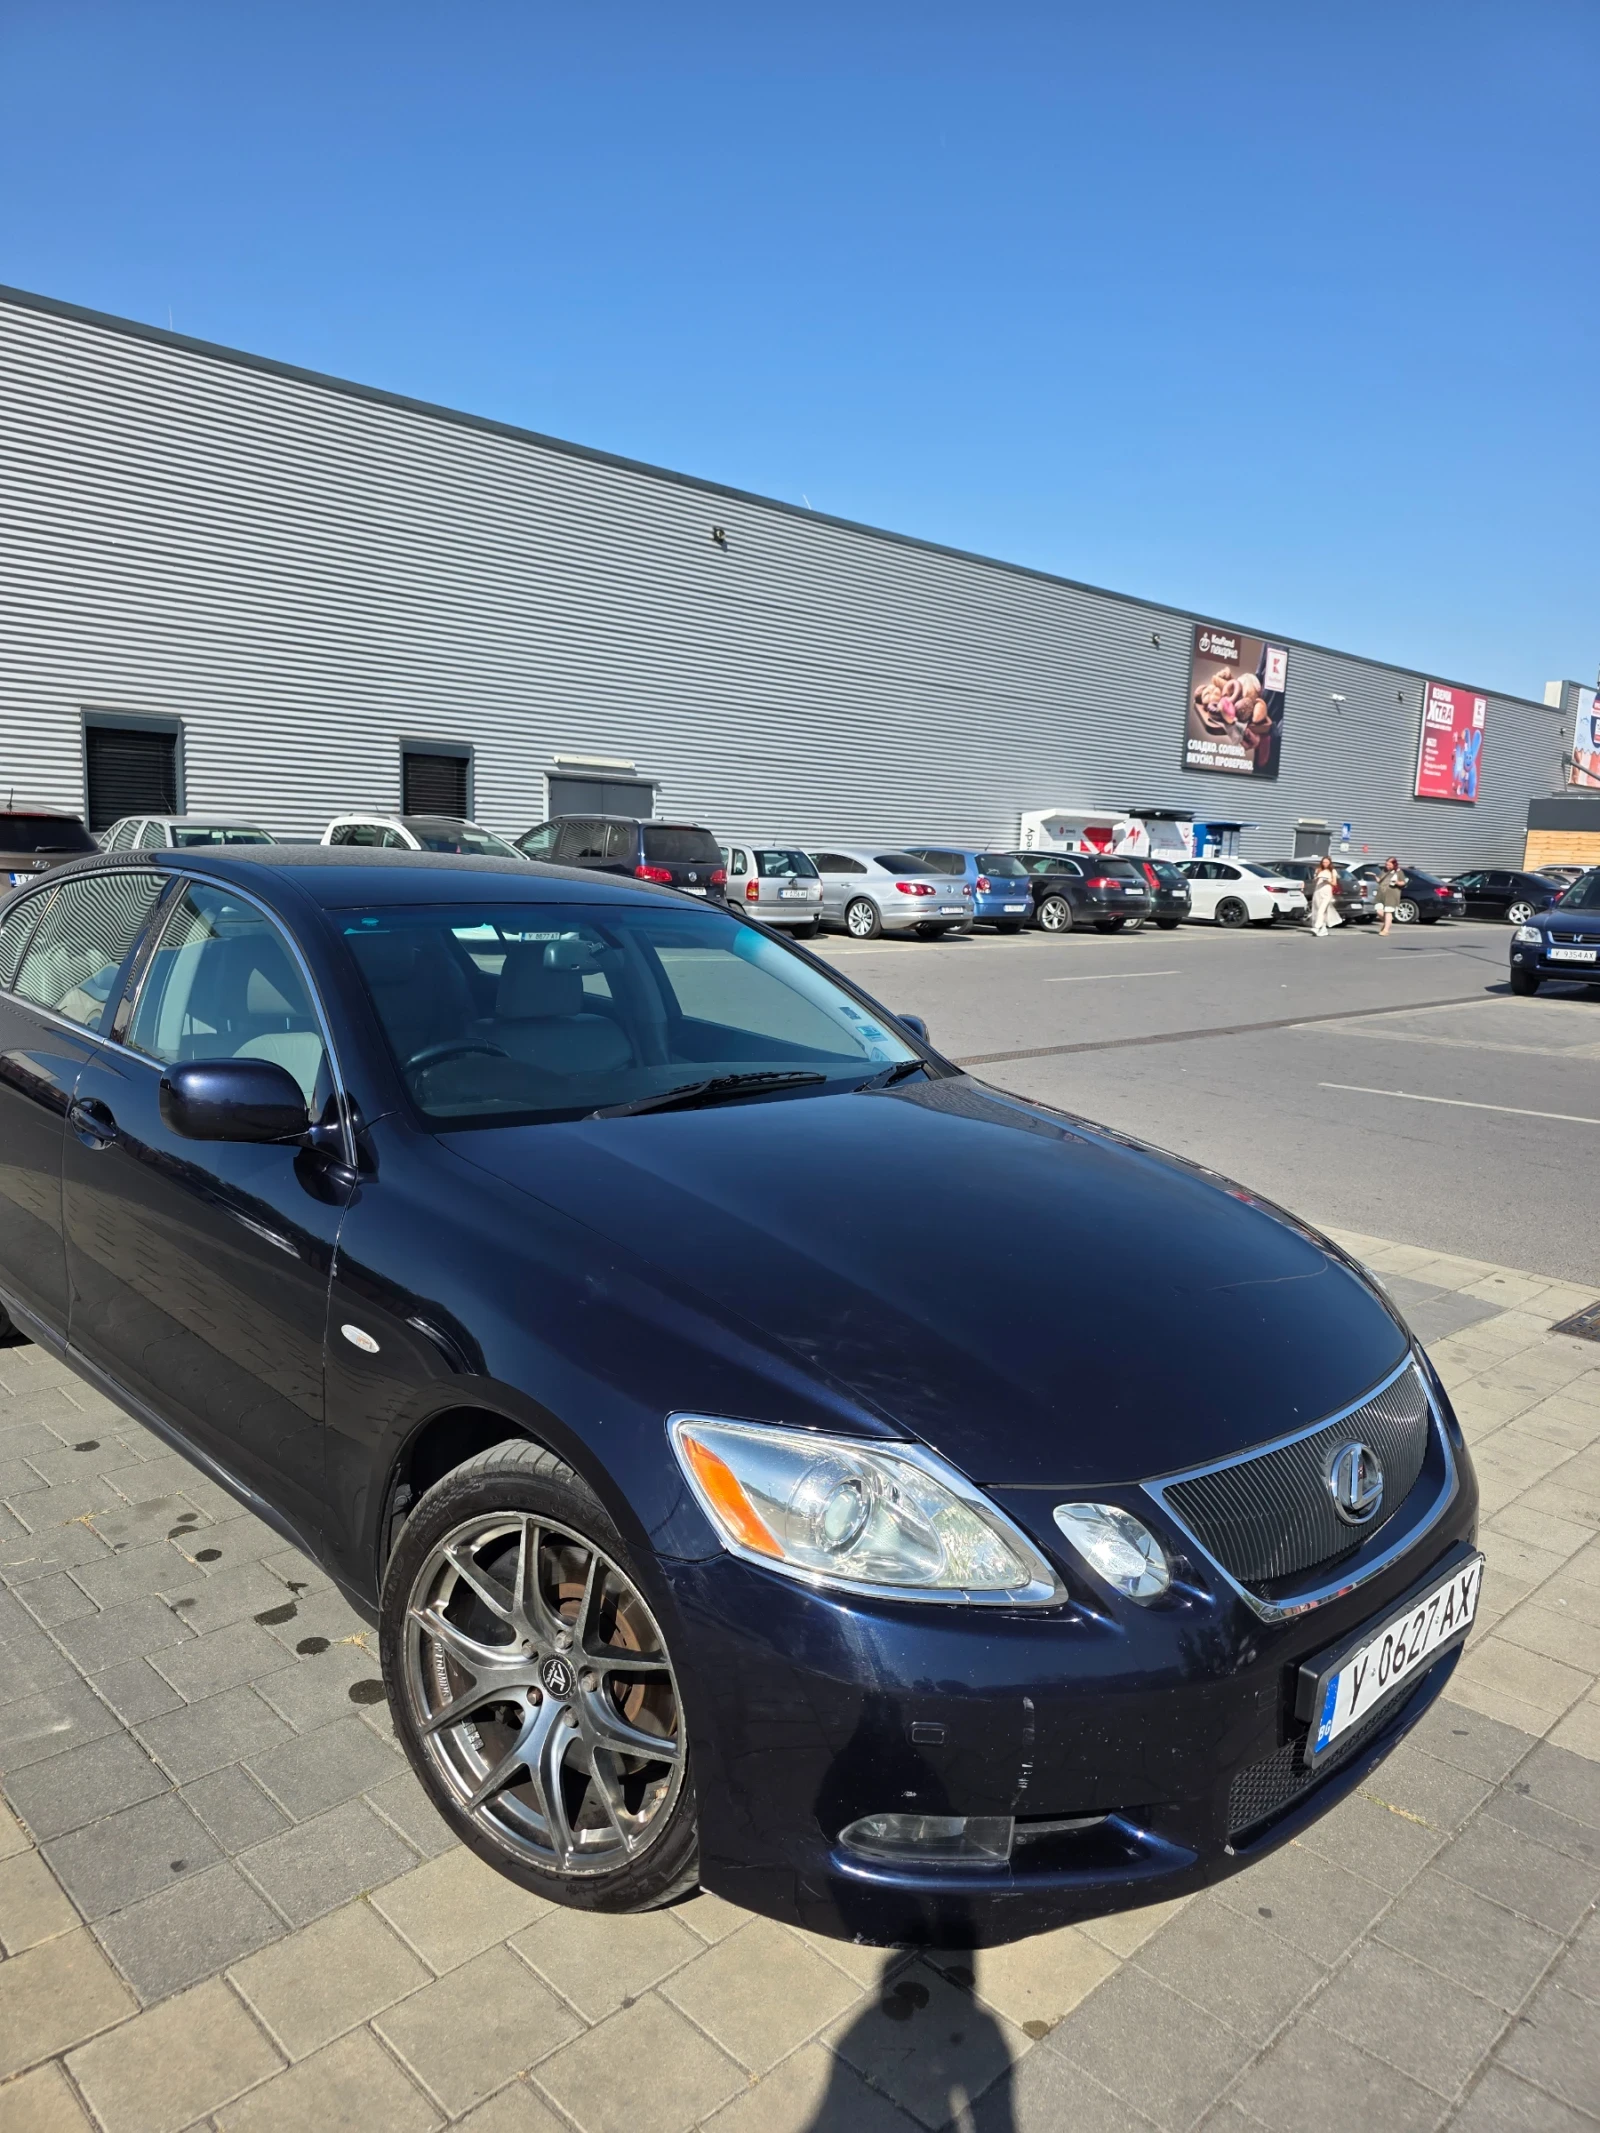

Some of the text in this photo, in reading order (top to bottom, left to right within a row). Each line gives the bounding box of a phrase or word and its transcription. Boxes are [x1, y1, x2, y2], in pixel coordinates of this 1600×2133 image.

[1564, 951, 1582, 959] 9354
[1584, 952, 1594, 960] AX
[1378, 1596, 1440, 1687] 0627
[1439, 1569, 1475, 1637] AX
[1318, 1721, 1332, 1741] BG
